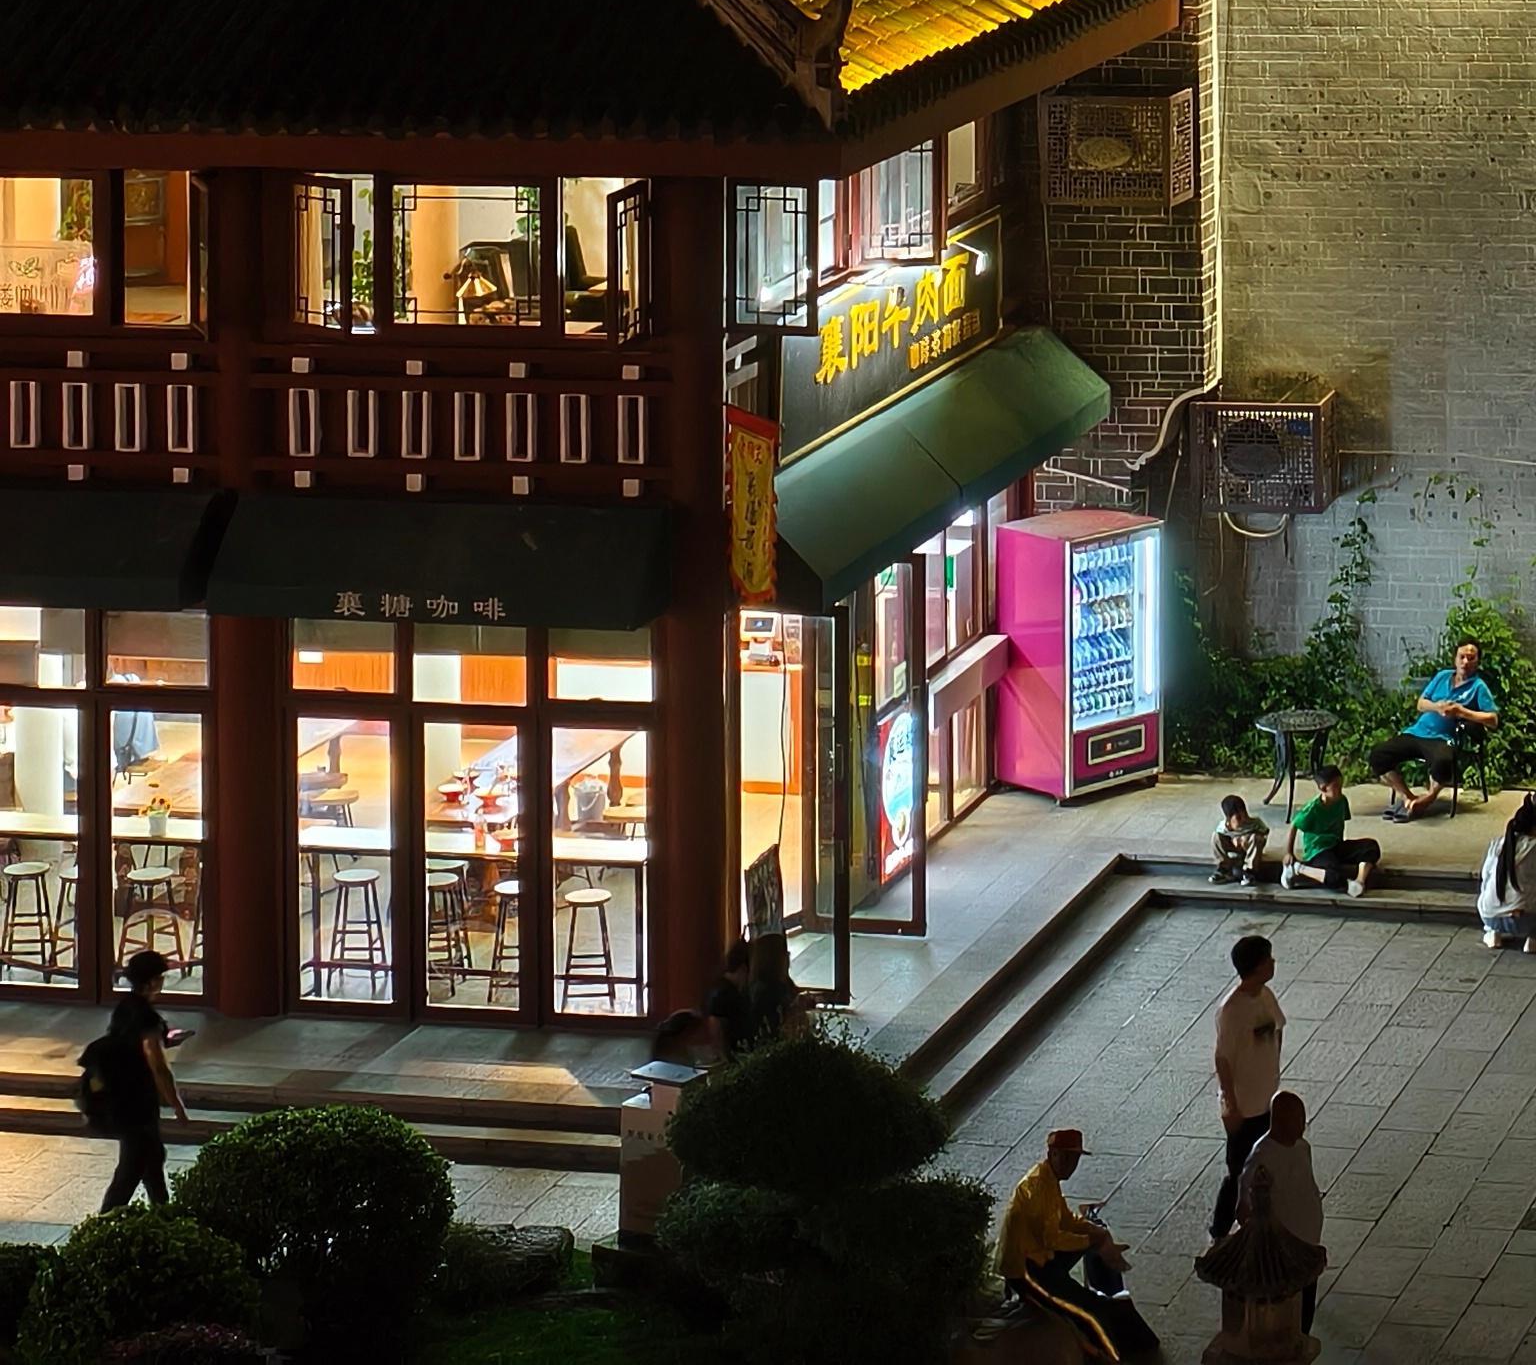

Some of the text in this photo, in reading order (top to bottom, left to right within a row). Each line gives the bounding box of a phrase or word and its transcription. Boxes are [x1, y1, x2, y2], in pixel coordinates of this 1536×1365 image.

[815, 252, 969, 384] 襄阳牛肉面
[334, 591, 506, 621] 襄糖咖啡
